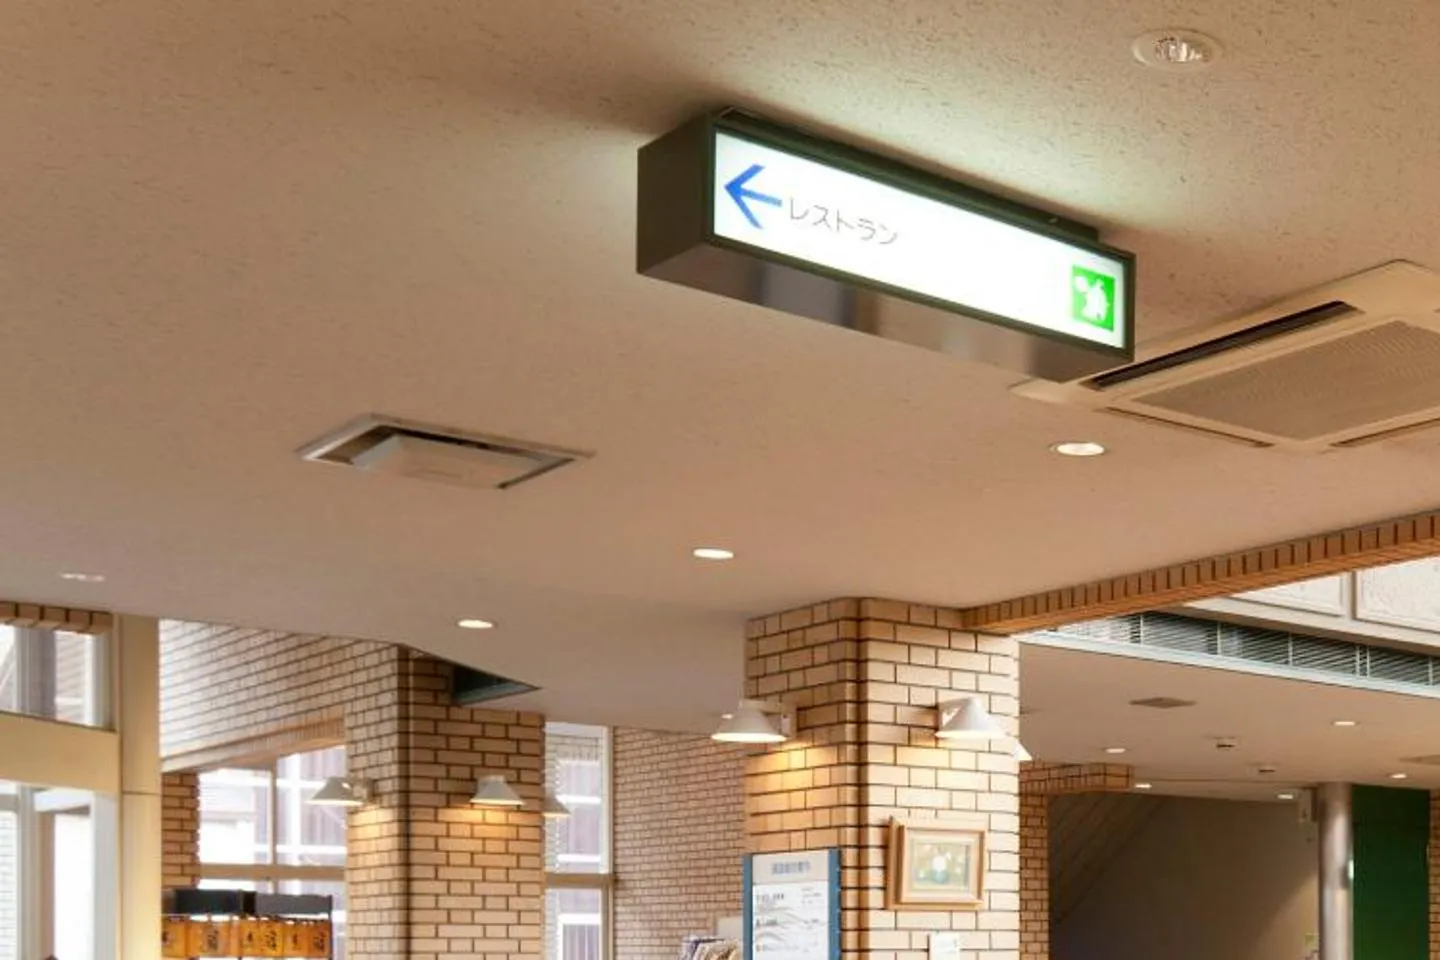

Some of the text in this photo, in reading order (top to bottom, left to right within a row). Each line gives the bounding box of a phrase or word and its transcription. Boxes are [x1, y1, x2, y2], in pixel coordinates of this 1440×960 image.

[789, 196, 898, 245] レストラン
